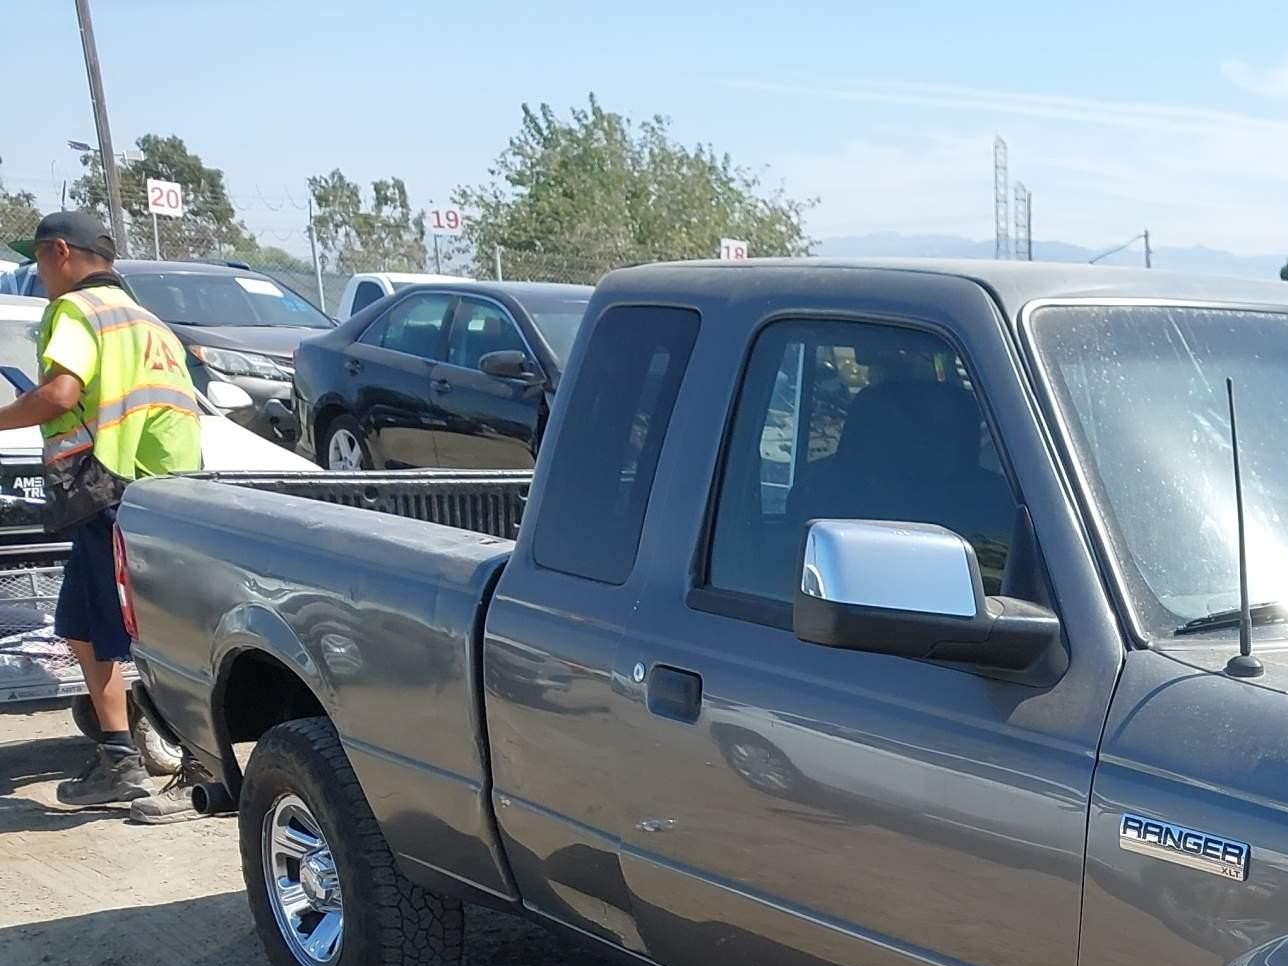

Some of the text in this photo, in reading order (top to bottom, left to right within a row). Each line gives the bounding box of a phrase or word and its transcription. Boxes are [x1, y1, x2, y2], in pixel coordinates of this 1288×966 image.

[150, 186, 179, 209] 20
[431, 210, 459, 229] 19
[1122, 816, 1244, 865] RANGER
[1220, 866, 1241, 879] XLT
